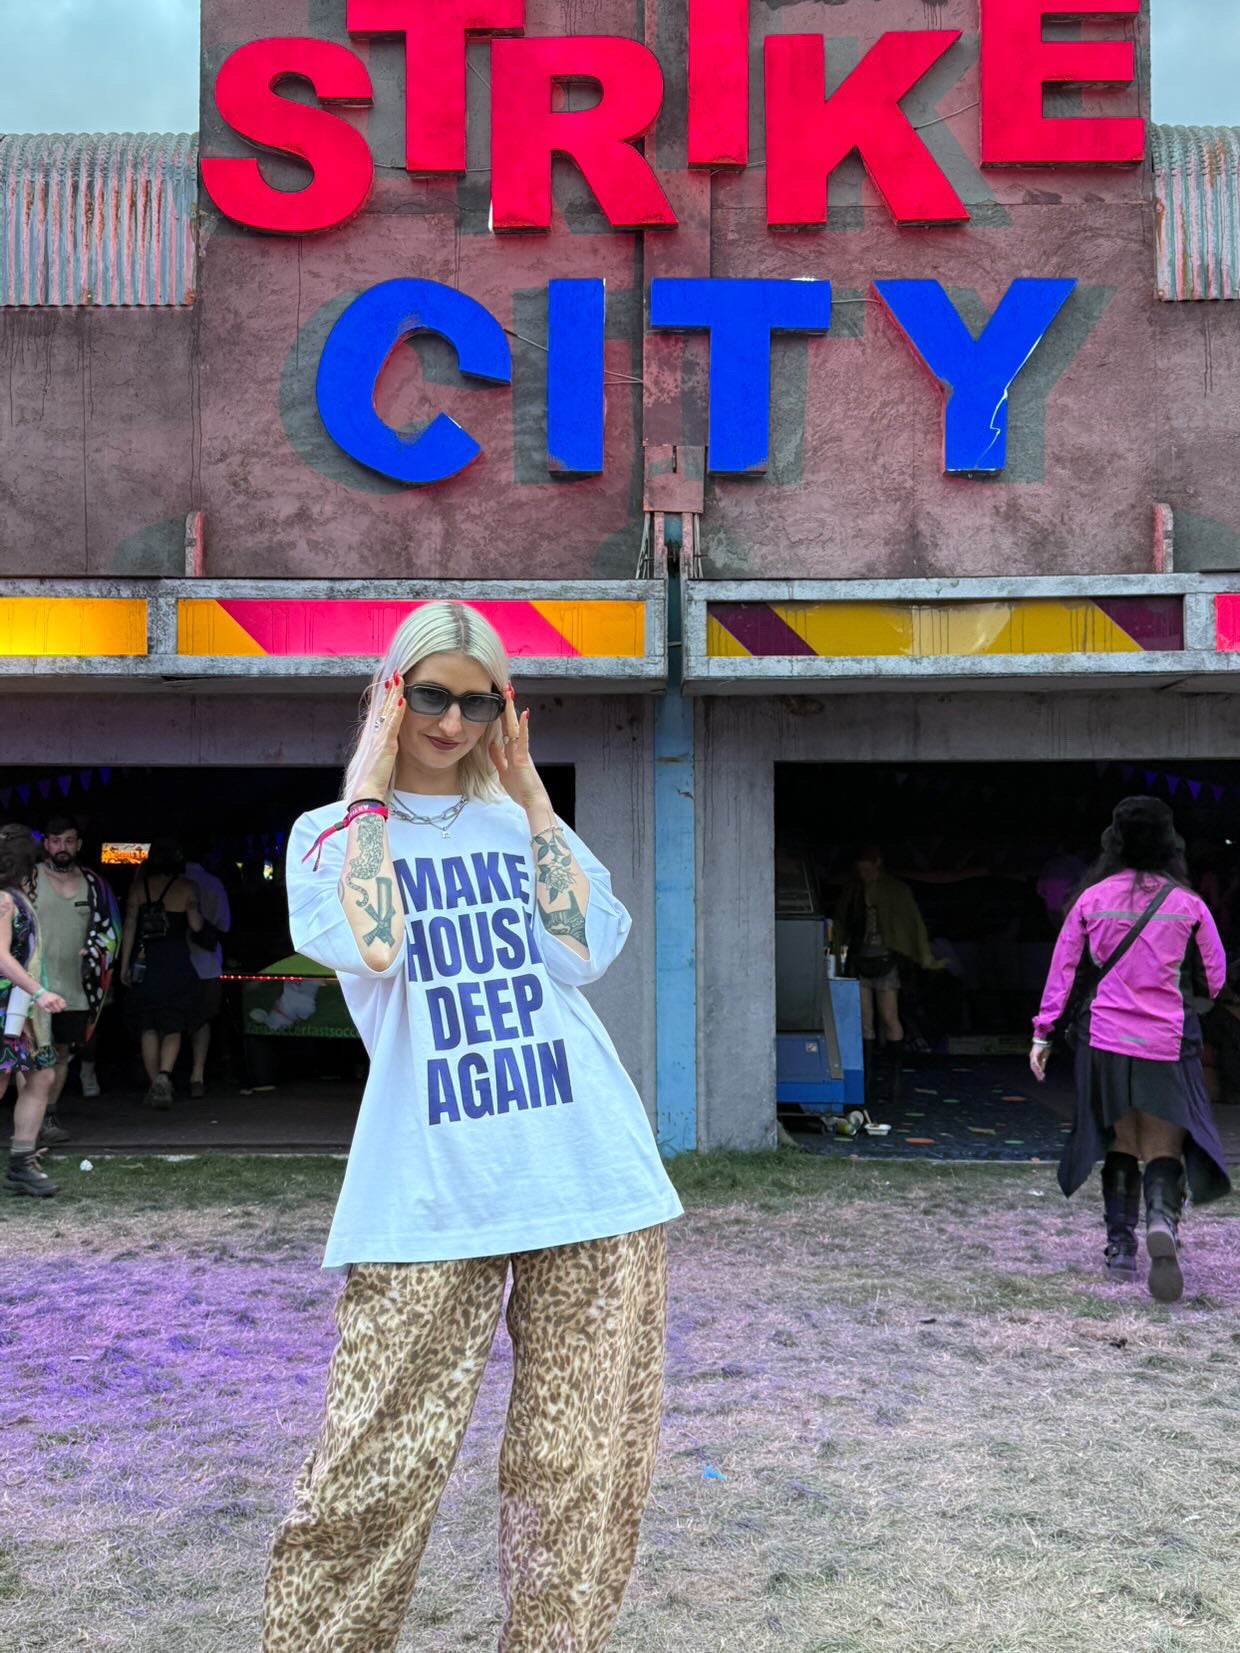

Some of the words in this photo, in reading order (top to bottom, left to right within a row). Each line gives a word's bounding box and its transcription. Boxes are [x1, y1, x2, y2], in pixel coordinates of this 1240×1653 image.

[200, 0, 1145, 233] STRIKE
[316, 277, 1077, 484] CITY
[393, 852, 530, 915] MAKE
[425, 973, 544, 1051] DEEP
[427, 1039, 574, 1126] AGAIN
